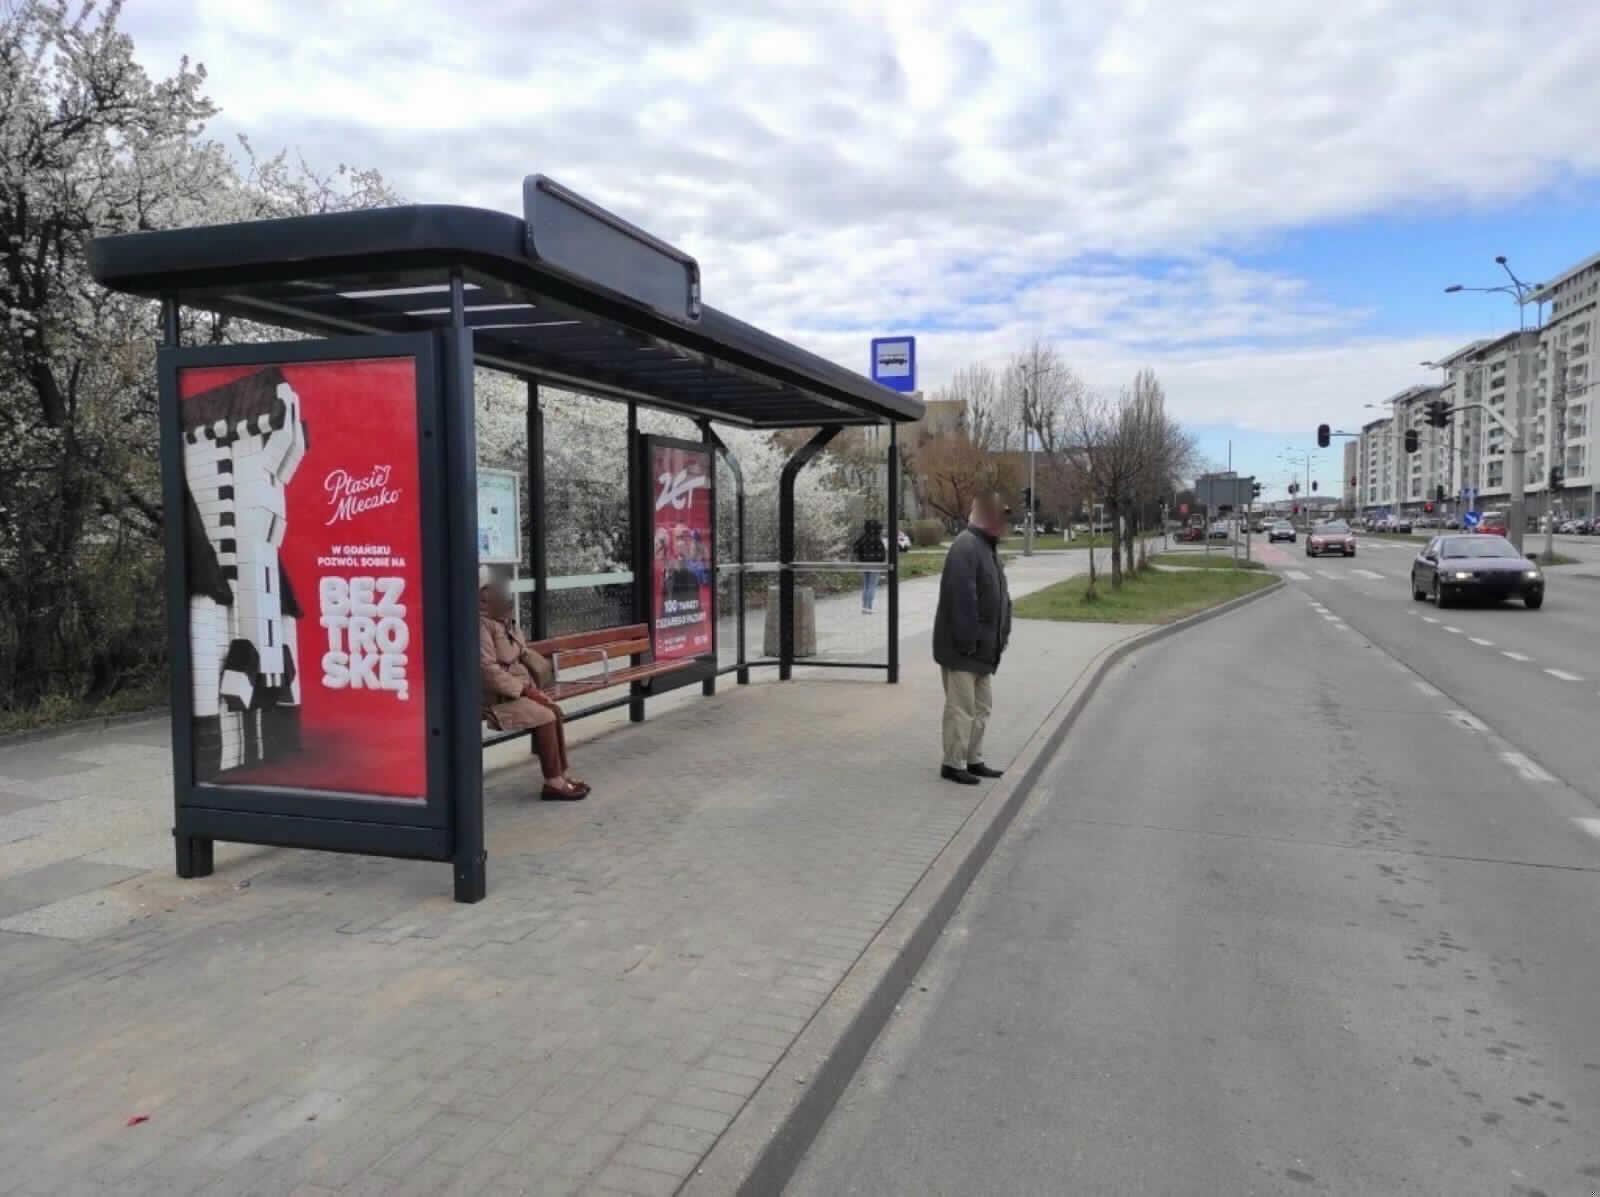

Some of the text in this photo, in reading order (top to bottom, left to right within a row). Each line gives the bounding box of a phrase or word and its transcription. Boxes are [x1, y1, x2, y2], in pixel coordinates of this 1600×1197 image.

[324, 464, 391, 504] Ptasie
[331, 545, 341, 554] W
[361, 557, 389, 566] SOBIE
[391, 557, 406, 567] NA
[319, 576, 406, 618] BEZ
[319, 614, 409, 655] TRO
[321, 652, 409, 701] SKĘ
